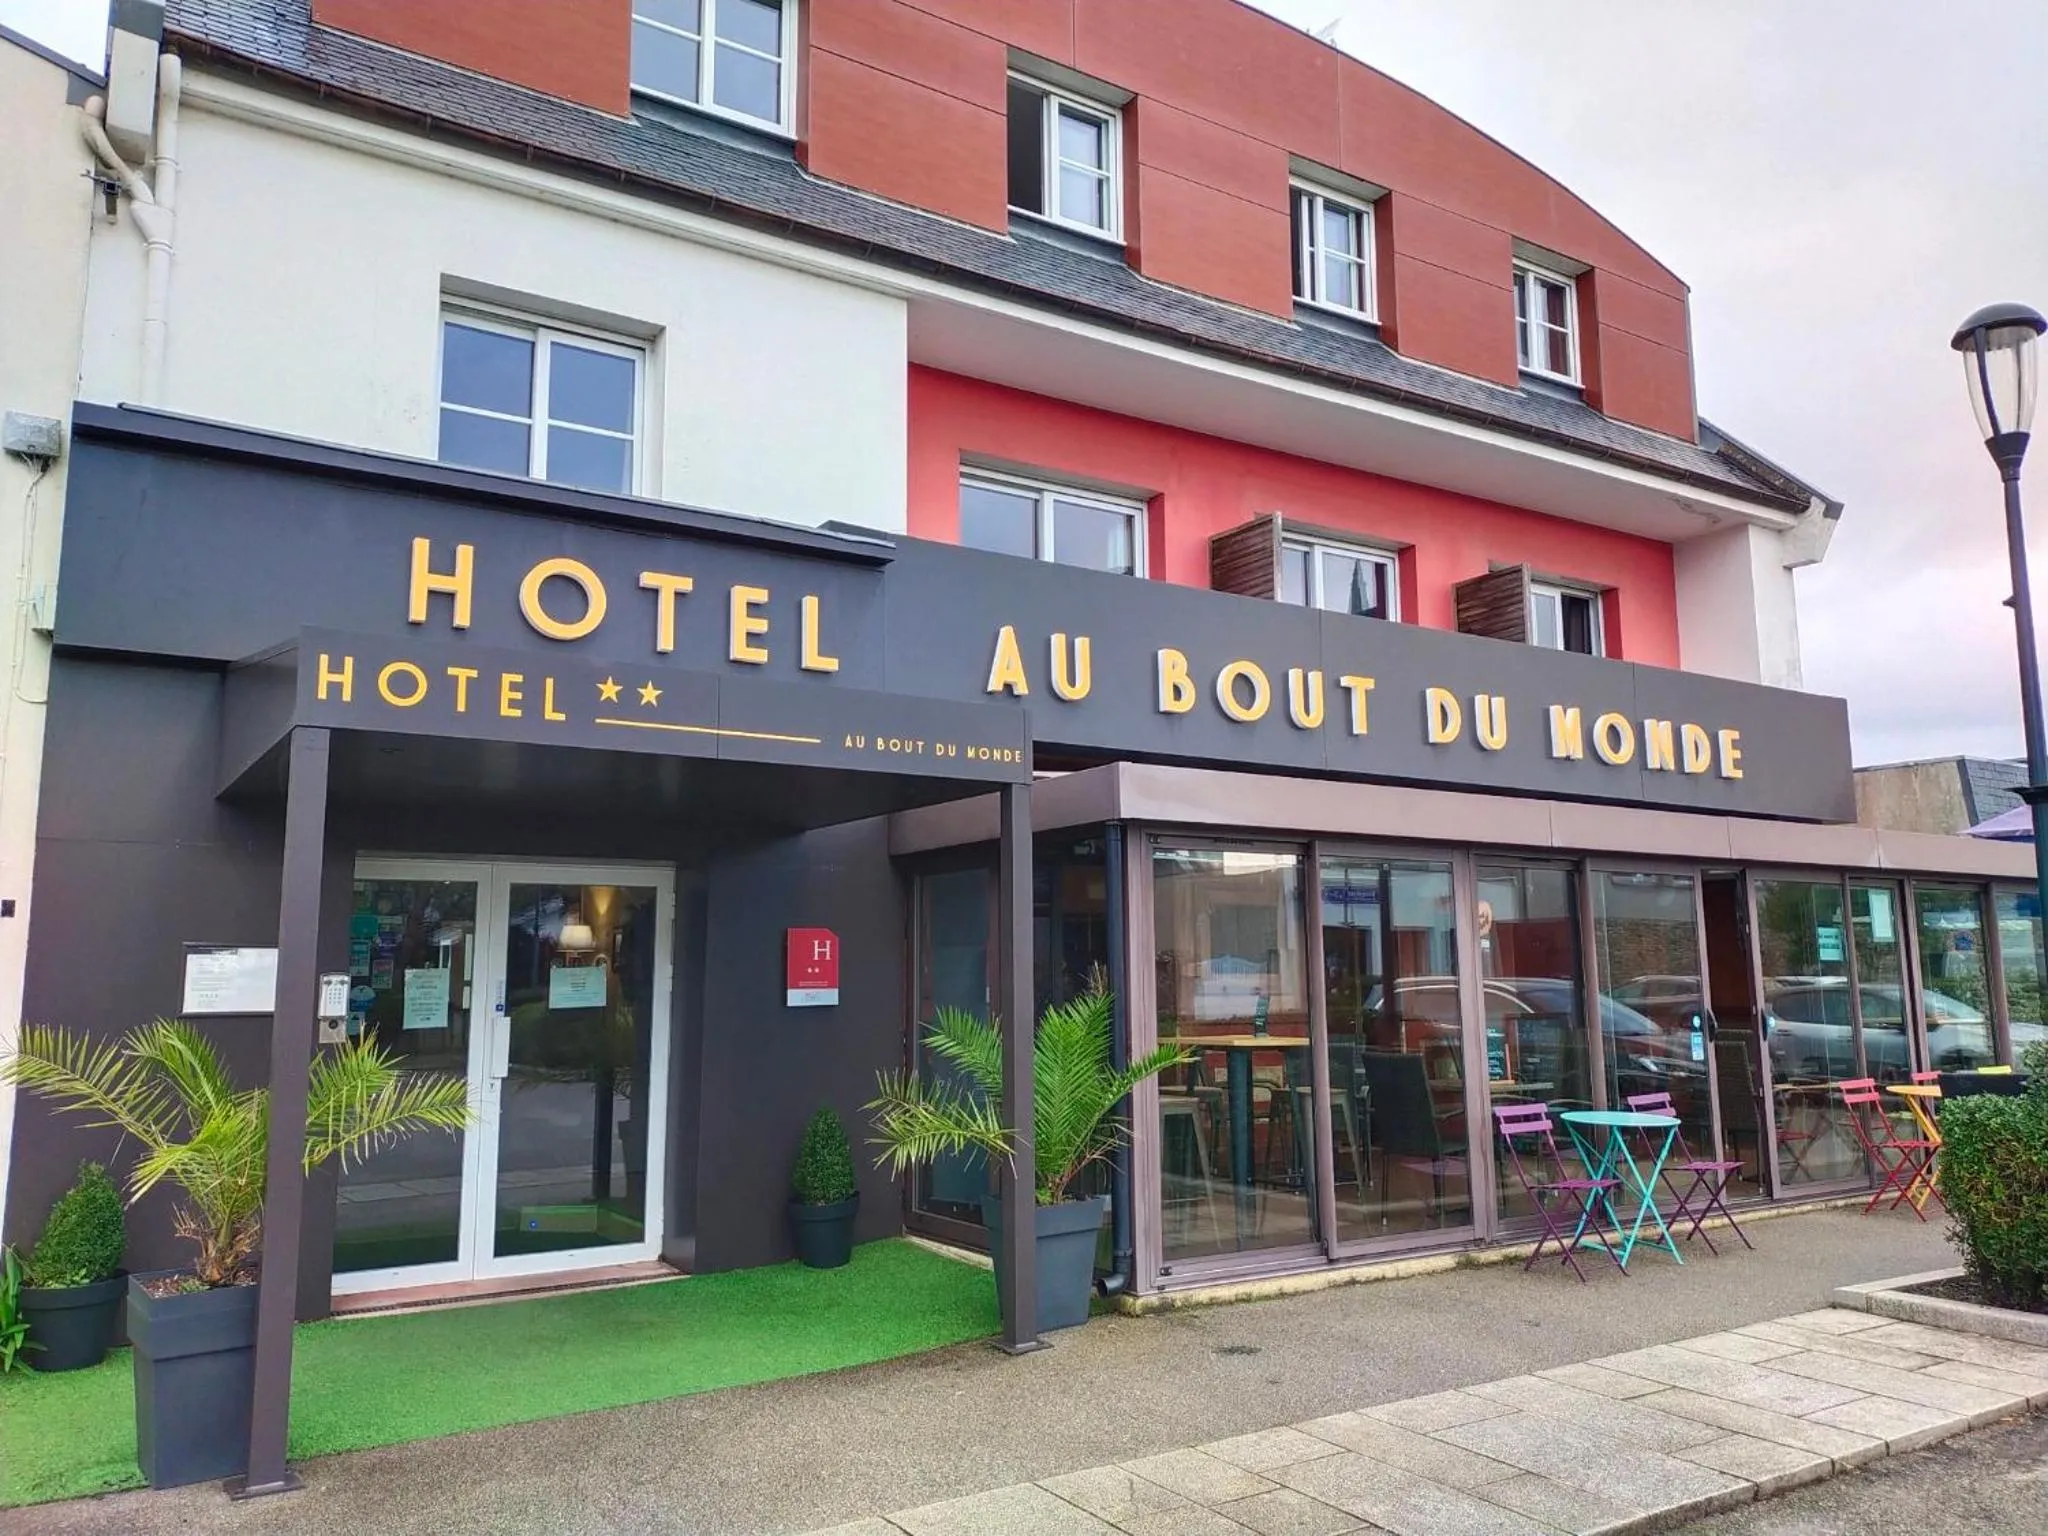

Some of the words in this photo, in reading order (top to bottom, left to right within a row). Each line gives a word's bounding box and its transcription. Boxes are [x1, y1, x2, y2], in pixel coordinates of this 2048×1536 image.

[408, 537, 840, 673] HOTEL
[316, 654, 567, 722] HOTEL
[987, 625, 1092, 703] AU
[1157, 648, 1377, 736] BOUT
[1426, 686, 1509, 752] DU
[1550, 704, 1745, 781] MONDE
[845, 734, 866, 749] AU
[877, 737, 926, 755] BOUT
[936, 743, 957, 758] DU
[967, 746, 1022, 764] MONDE
[813, 939, 832, 961] H
